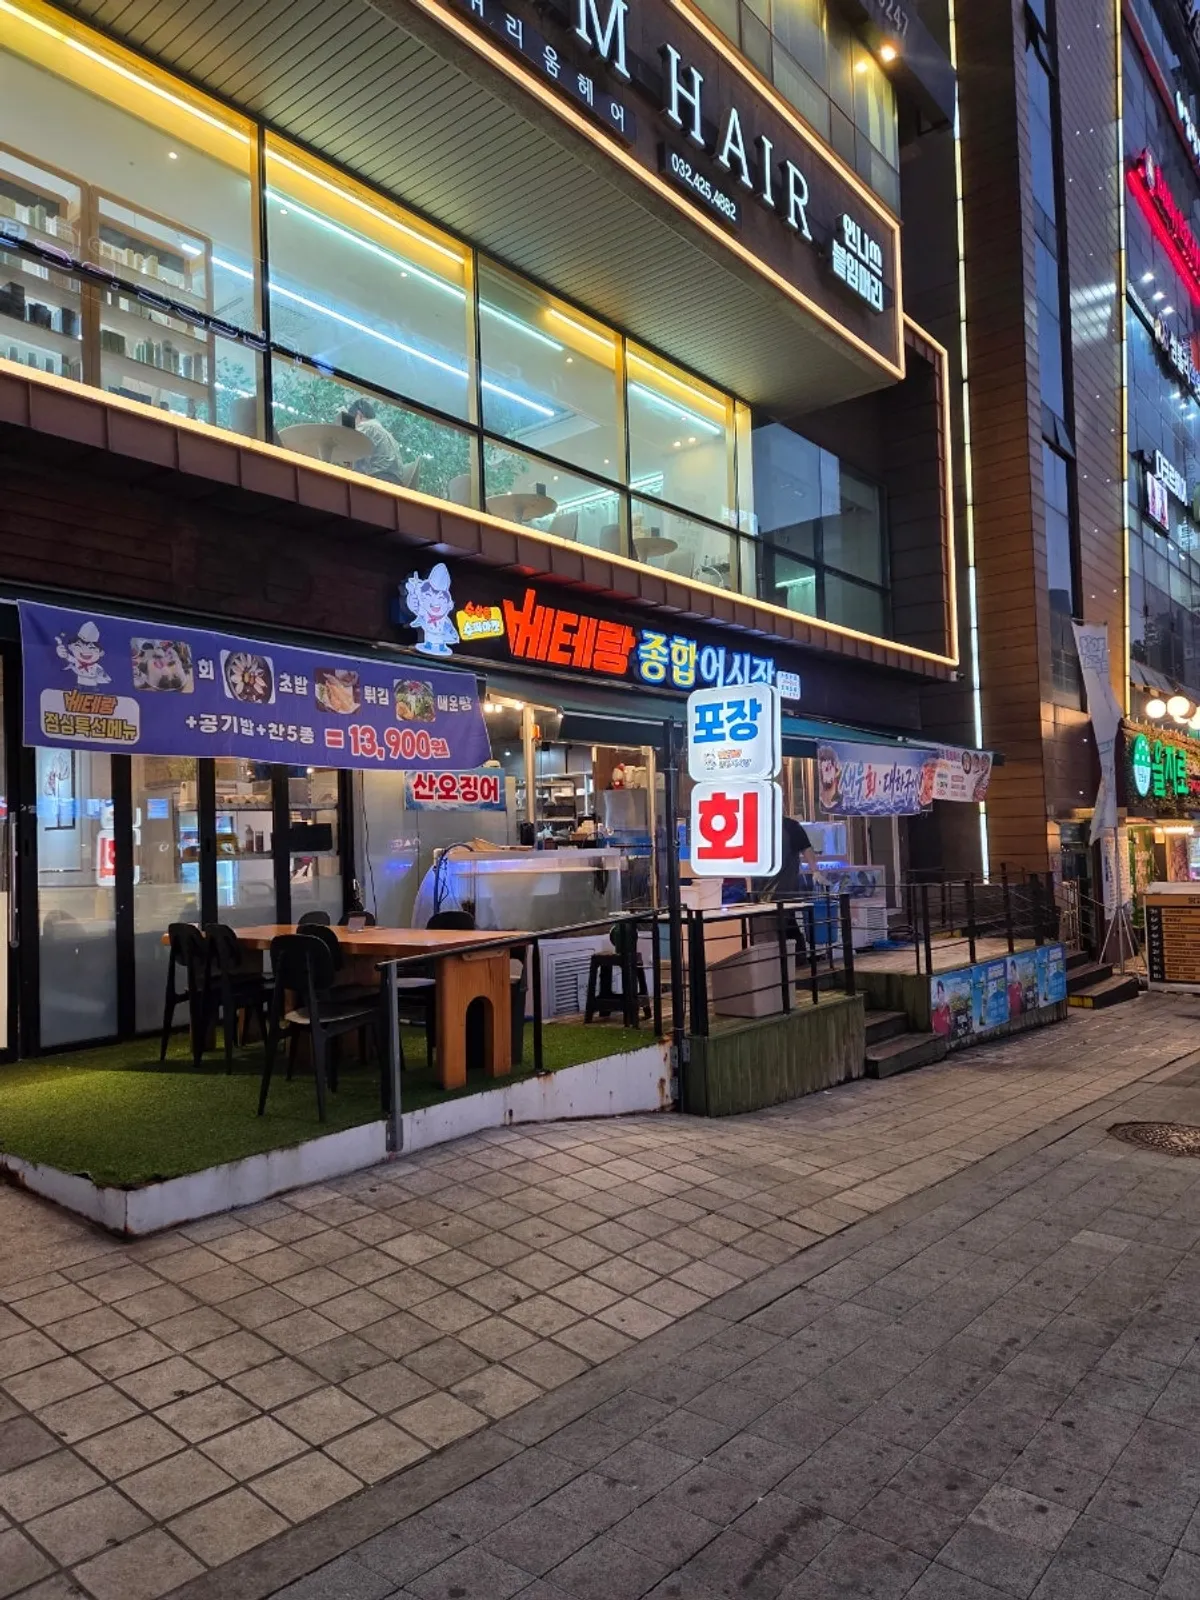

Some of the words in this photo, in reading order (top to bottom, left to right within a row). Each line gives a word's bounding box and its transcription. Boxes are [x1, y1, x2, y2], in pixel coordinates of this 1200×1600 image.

[666, 44, 812, 241] HAIR
[503, 588, 636, 675] 베테랑
[63, 689, 118, 715] 베테랑
[198, 659, 214, 680] 회
[279, 672, 308, 696] 초밥
[364, 686, 389, 706] 튀김
[438, 694, 472, 712] 매운탕
[44, 711, 137, 741] 점심특선메뉴
[693, 698, 762, 744] 포장
[413, 772, 500, 804] 산오징어
[697, 792, 758, 863] 회
